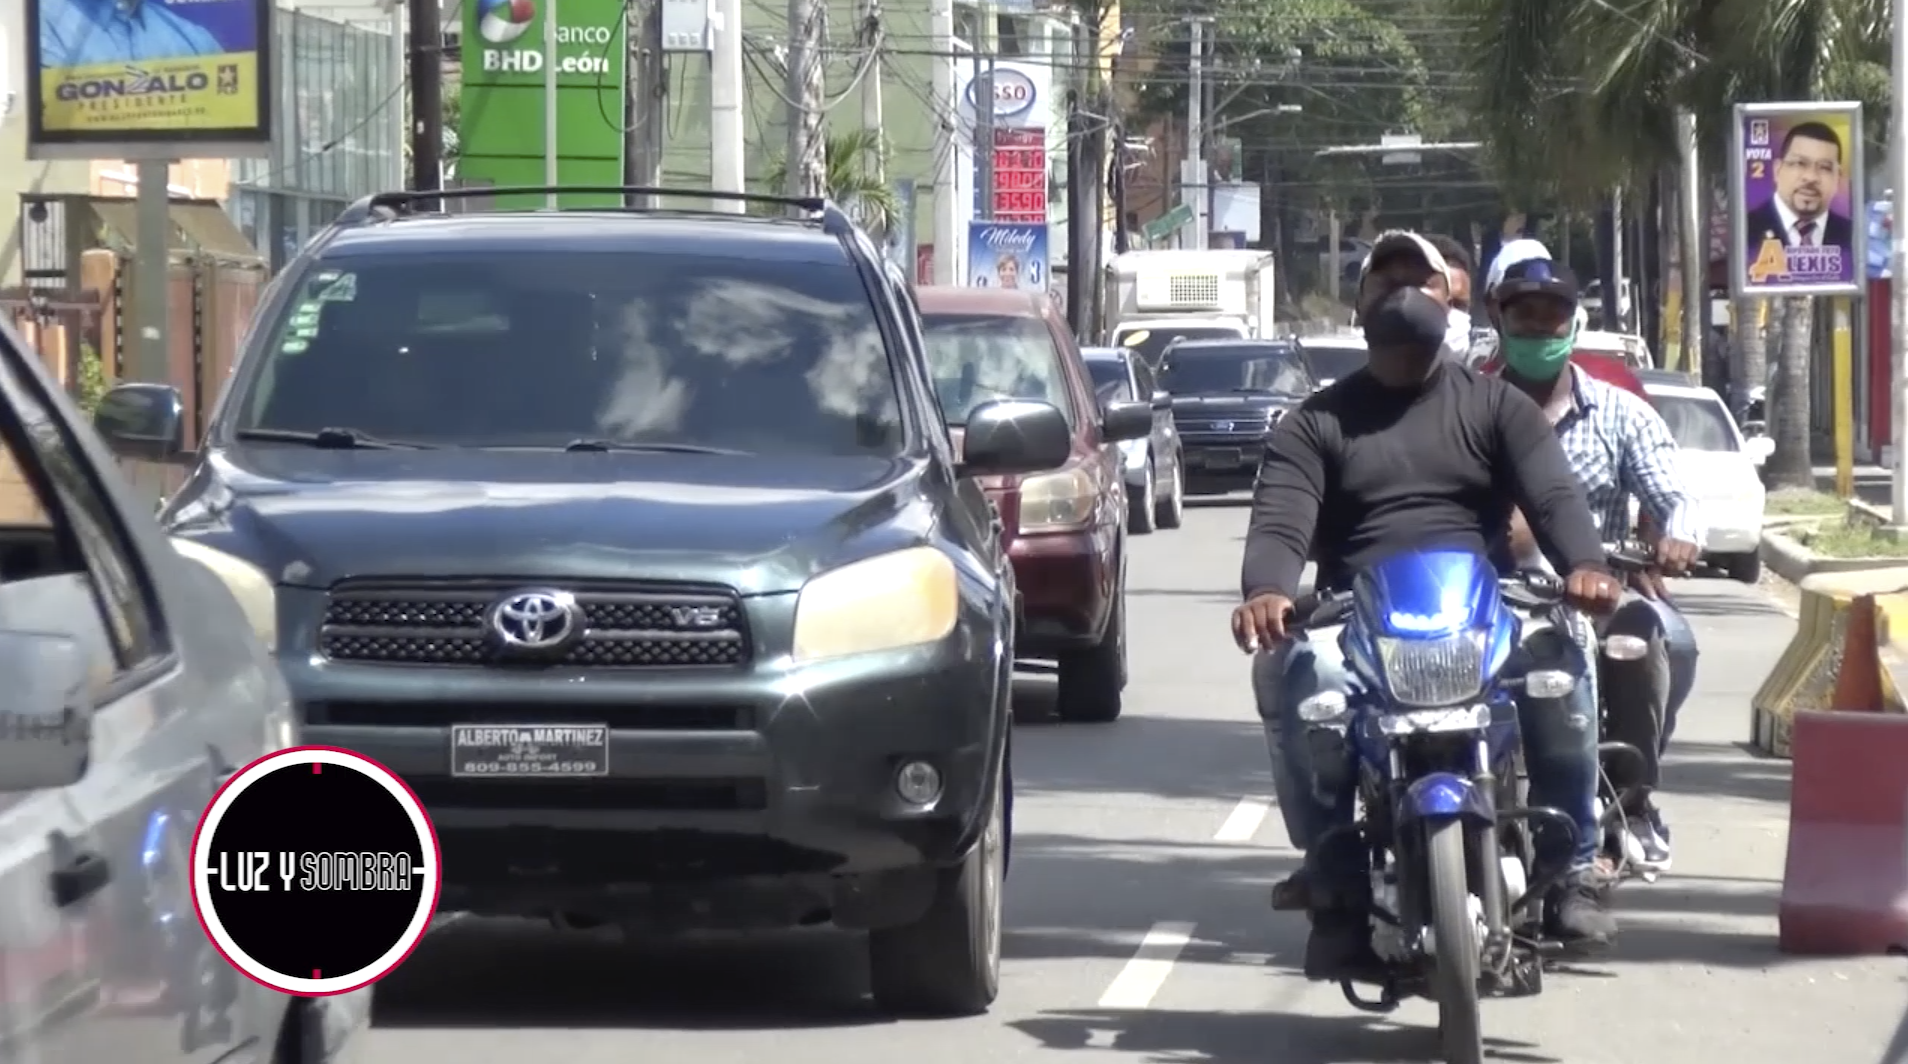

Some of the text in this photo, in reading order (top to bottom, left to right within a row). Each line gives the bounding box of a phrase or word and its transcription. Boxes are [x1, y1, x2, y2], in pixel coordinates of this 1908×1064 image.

[483, 49, 543, 72] BHD
[56, 65, 208, 101] GONZALO
[1746, 148, 1772, 160] VOTA
[1751, 161, 1765, 179] 2
[1749, 239, 1841, 282] ALEXIS
[1031, 260, 1040, 285] 3
[457, 729, 603, 746] ALBERTO MARTINEZ
[464, 762, 597, 773] 809-855-4599
